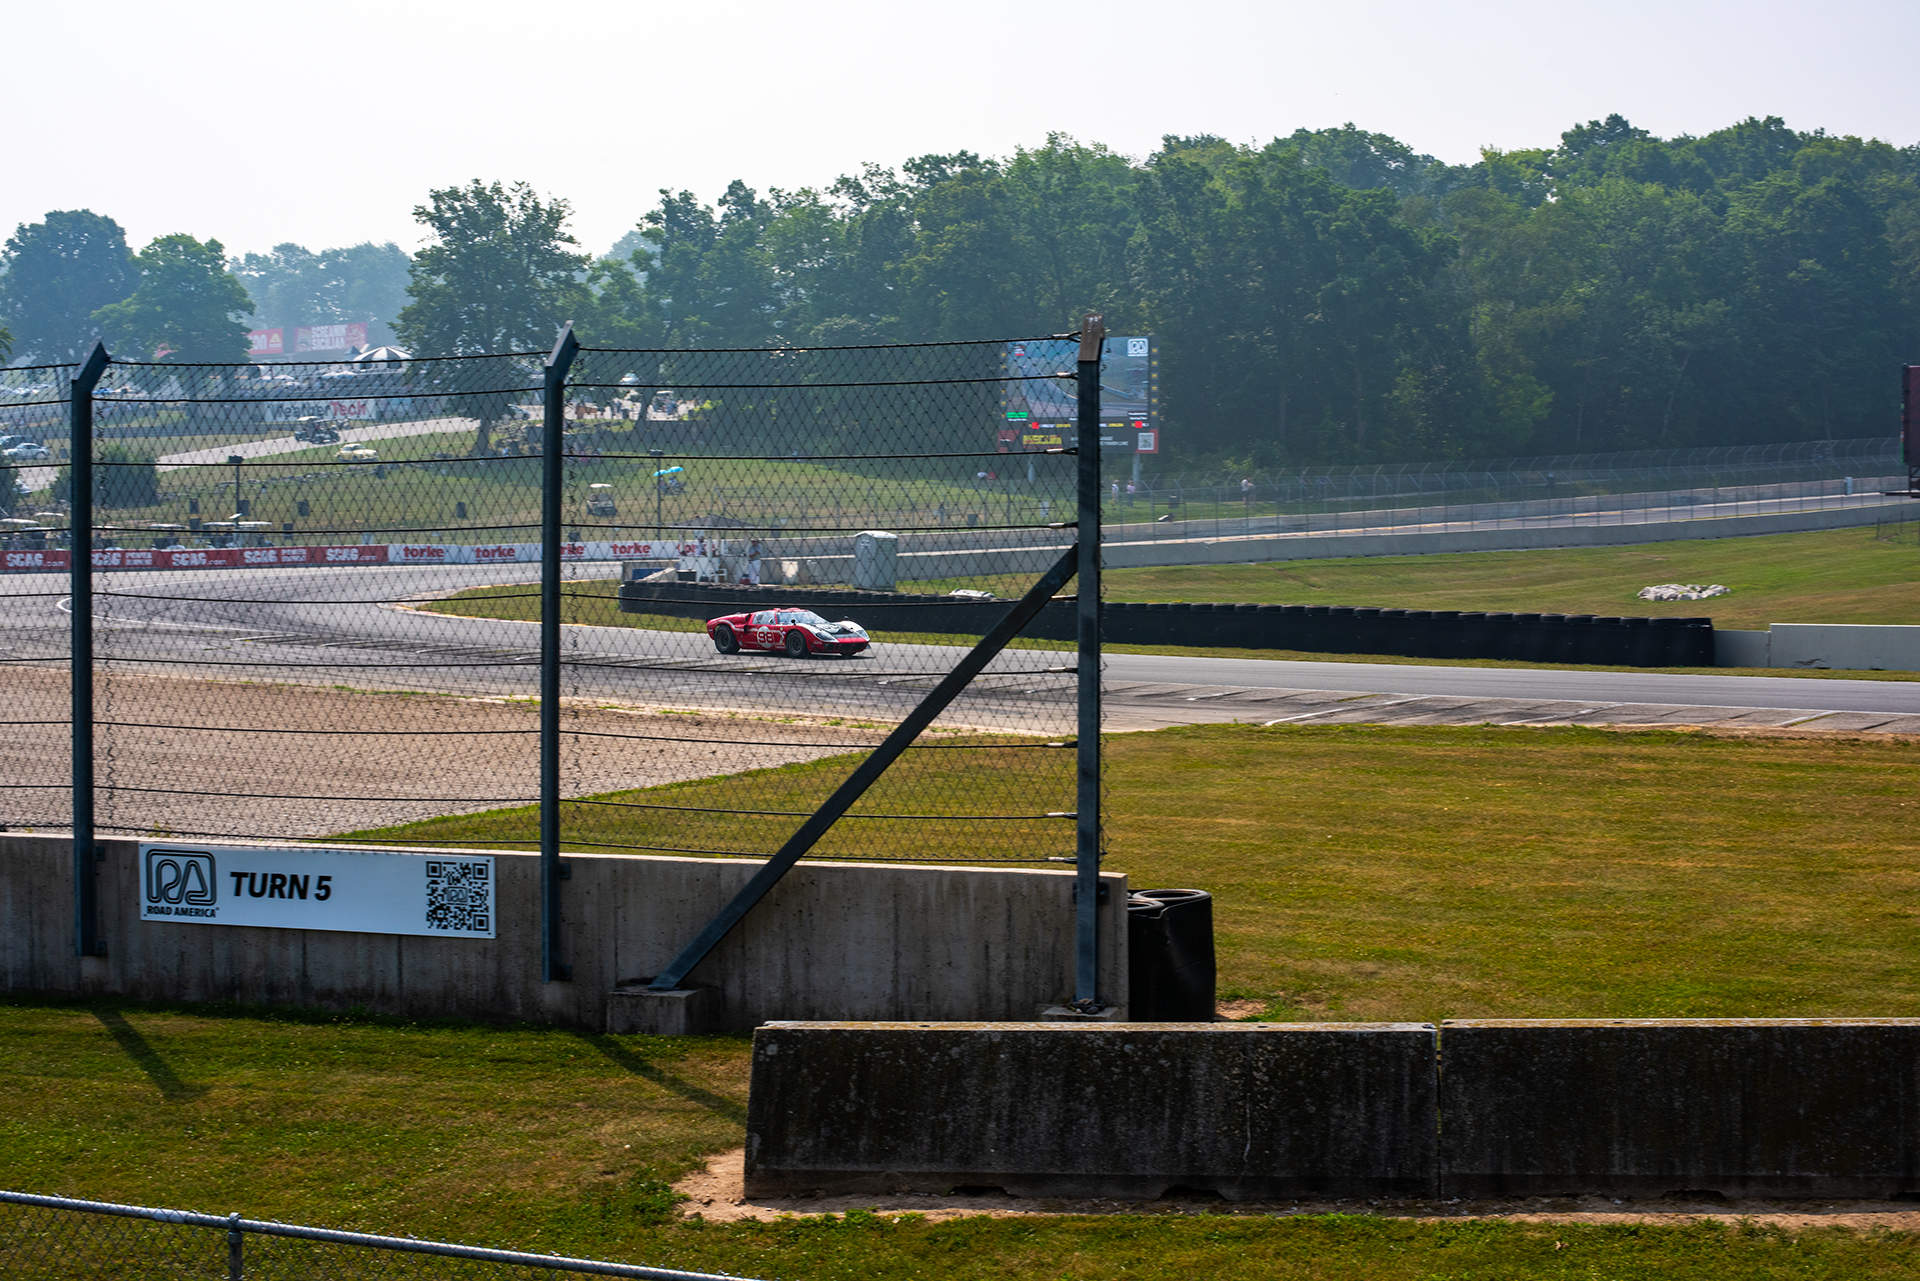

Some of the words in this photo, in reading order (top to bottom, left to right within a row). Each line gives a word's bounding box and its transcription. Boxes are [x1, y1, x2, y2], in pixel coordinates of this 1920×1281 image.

[311, 337, 346, 351] SICILIAN
[271, 400, 366, 419] WeatherTech
[326, 548, 377, 561] SCAG.com
[403, 546, 445, 558] torke
[475, 546, 516, 558] torke
[560, 543, 585, 555] rke
[612, 543, 651, 554] torke
[6, 553, 65, 567] SCAG.com
[172, 552, 227, 566] SCAG.com
[243, 549, 278, 564] SCAG
[758, 632, 774, 644] 98
[230, 871, 310, 900] TURN
[314, 875, 333, 902] 5
[146, 905, 173, 915] ROAD
[173, 906, 217, 918] AMERICA
